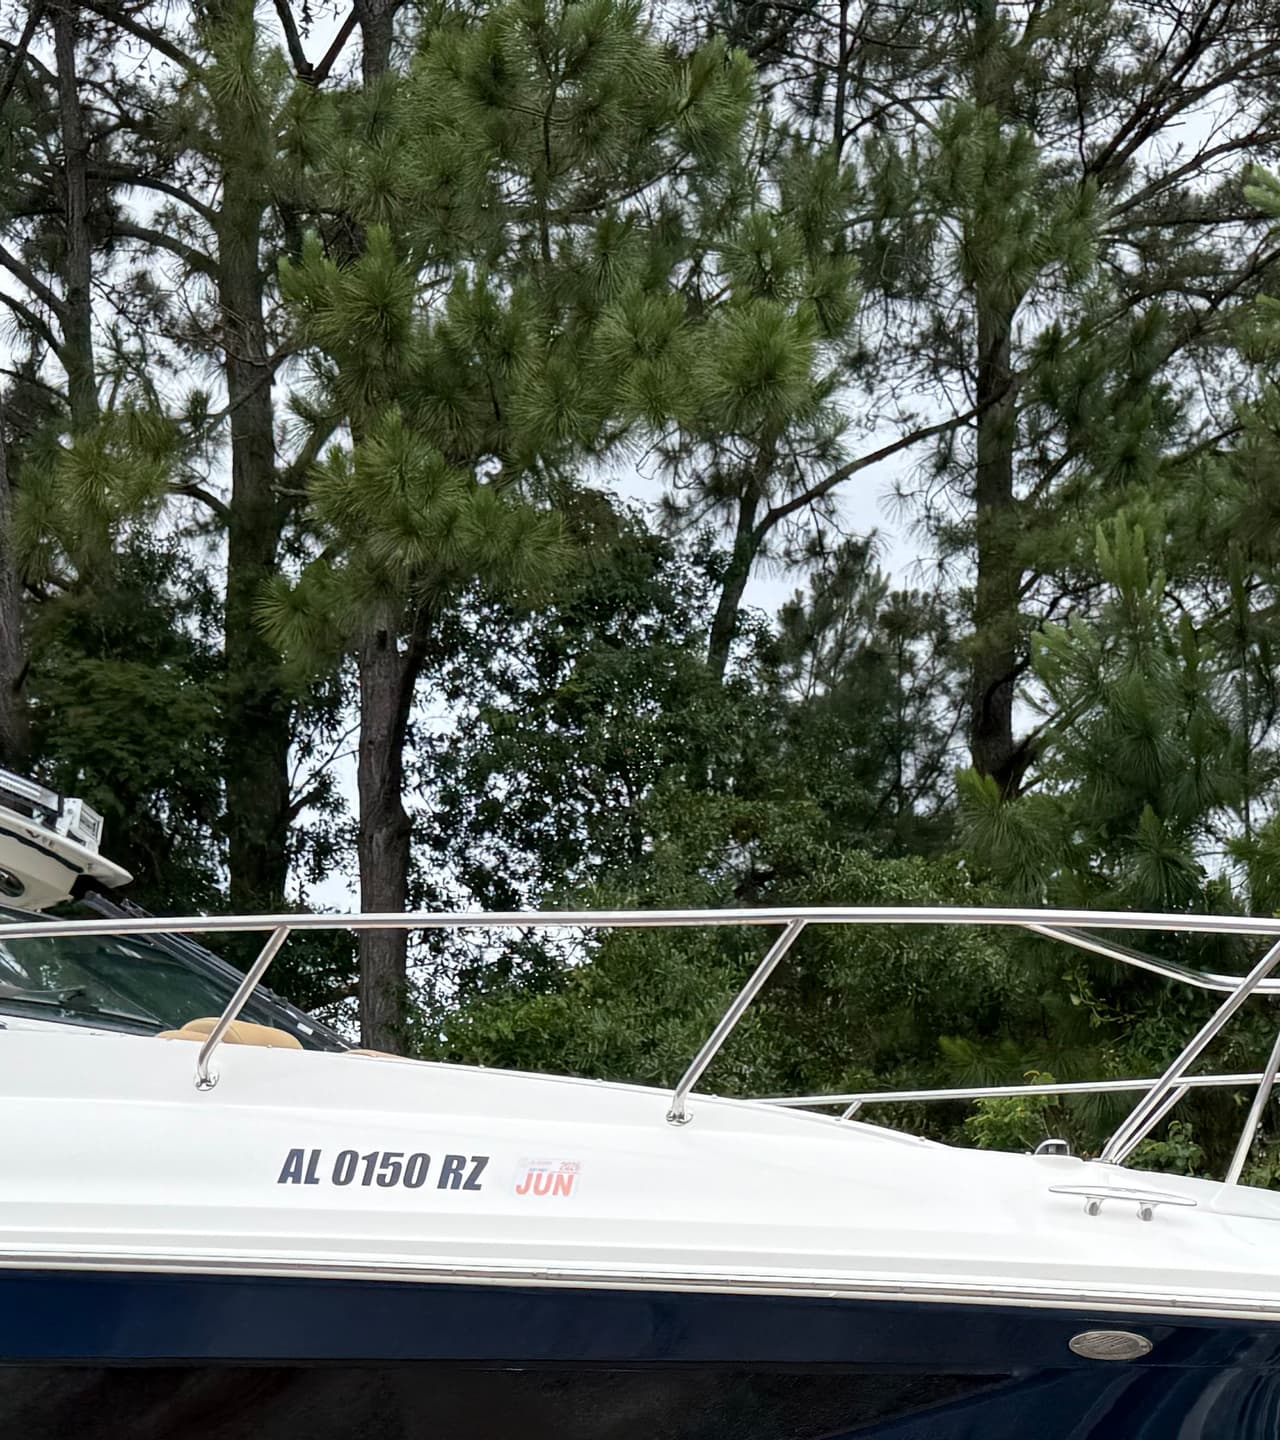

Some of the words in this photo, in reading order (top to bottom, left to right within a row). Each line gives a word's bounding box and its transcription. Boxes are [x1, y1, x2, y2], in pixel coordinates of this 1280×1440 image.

[277, 1148, 322, 1185] AL
[331, 1149, 431, 1189] 0150
[437, 1154, 490, 1191] RZ
[515, 1172, 575, 1197] JUN
